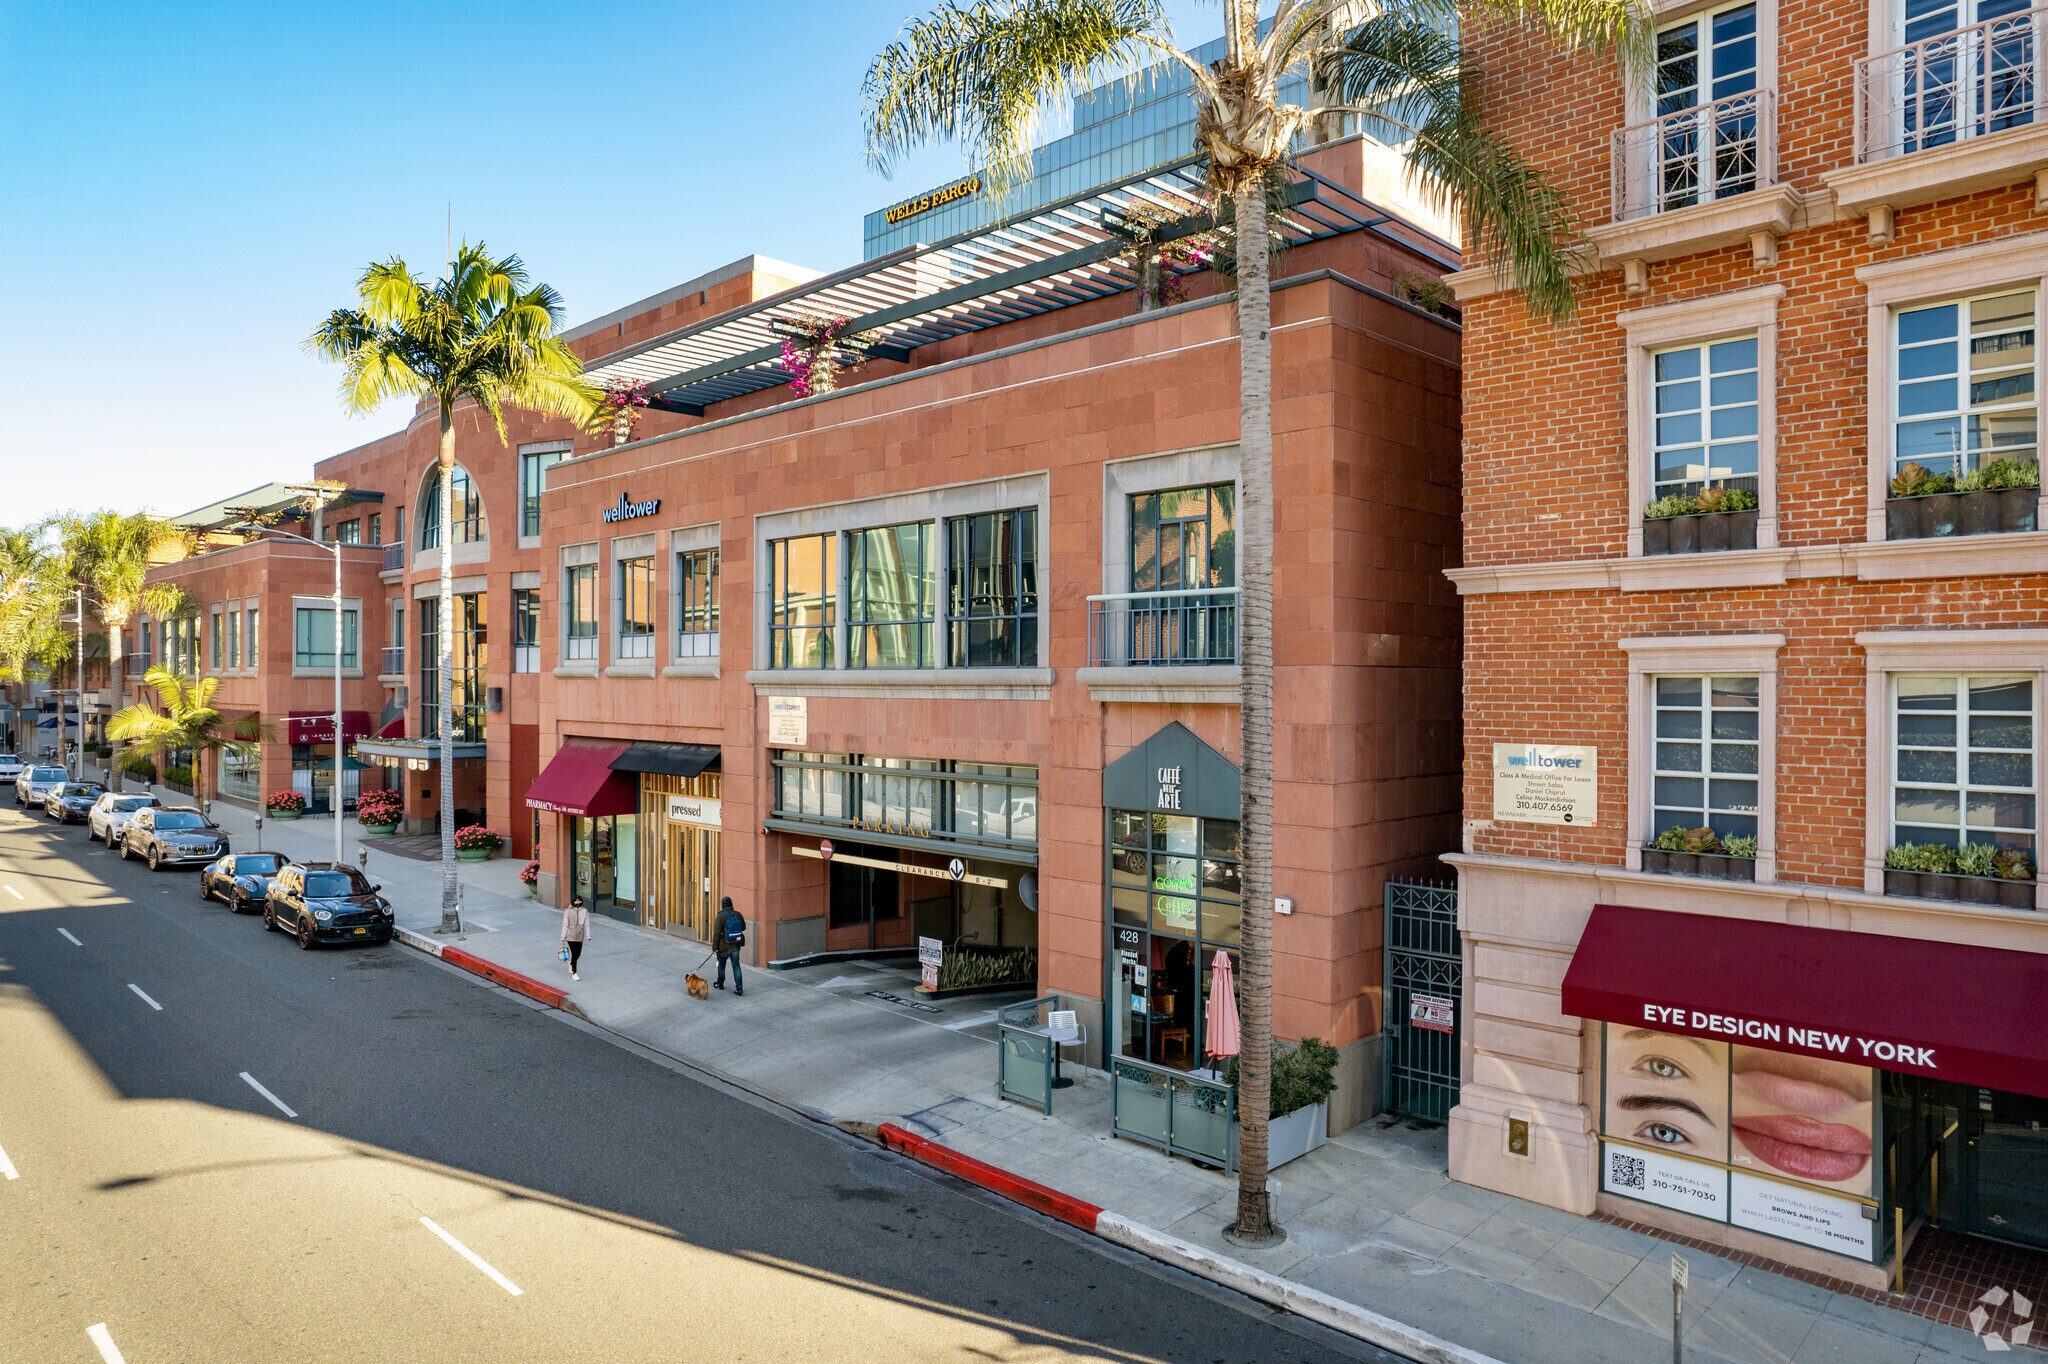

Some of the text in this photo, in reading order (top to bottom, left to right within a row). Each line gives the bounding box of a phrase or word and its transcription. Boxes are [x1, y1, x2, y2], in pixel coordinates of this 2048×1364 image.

[884, 177, 981, 223] WELLS FARGO
[602, 492, 660, 522] welltower
[1508, 748, 1582, 769] welltower
[1158, 766, 1182, 785] CAFFÉ
[526, 798, 553, 811] PHARMACY
[1158, 788, 1182, 810] ARTE
[1516, 801, 1573, 812] 310.407.6569
[671, 804, 702, 817] pressed
[853, 816, 929, 838] PARKING
[895, 864, 946, 878] CLEARANCE
[1120, 930, 1139, 944] 428
[1432, 997, 1452, 1006] SECURITY
[1431, 1010, 1438, 1018] NO
[1644, 1004, 1937, 1068] EYE DESIGN NEW YORK
[1733, 1154, 1752, 1164] LIPS
[1658, 1171, 1673, 1180] TEXT
[1685, 1178, 1701, 1186] CALL
[1652, 1179, 1716, 1201] 310-751-7030
[1759, 1192, 1843, 1218] GET NATURAL LOOKING
[1772, 1206, 1831, 1226] BROWS AND LIPS
[1741, 1208, 1765, 1218] WHICH
[1765, 1214, 1785, 1224] LASTS
[1787, 1220, 1801, 1228] FOR
[1833, 1232, 1865, 1245] MONTHS
